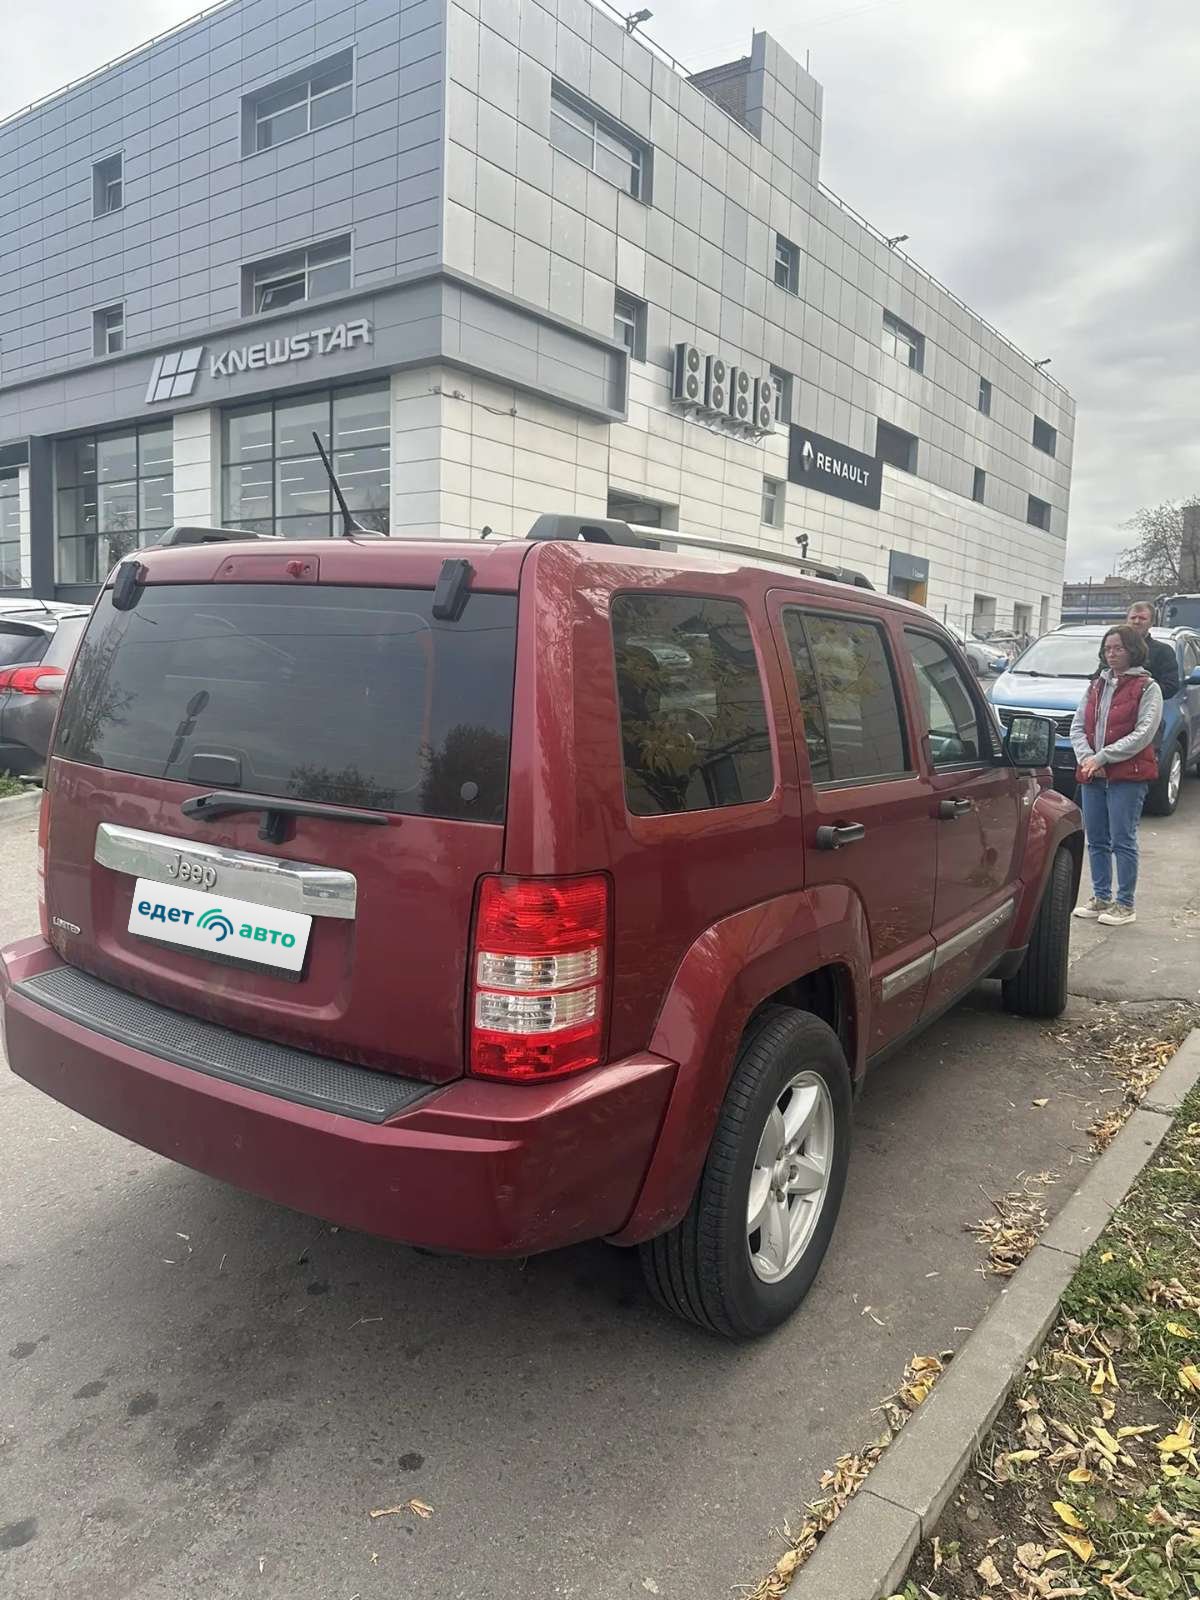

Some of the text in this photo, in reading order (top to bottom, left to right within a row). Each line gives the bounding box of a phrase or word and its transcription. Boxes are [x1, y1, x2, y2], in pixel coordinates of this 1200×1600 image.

[210, 318, 373, 377] KNEWSTAR
[816, 452, 870, 486] RENAULT
[167, 854, 217, 890] Jeep
